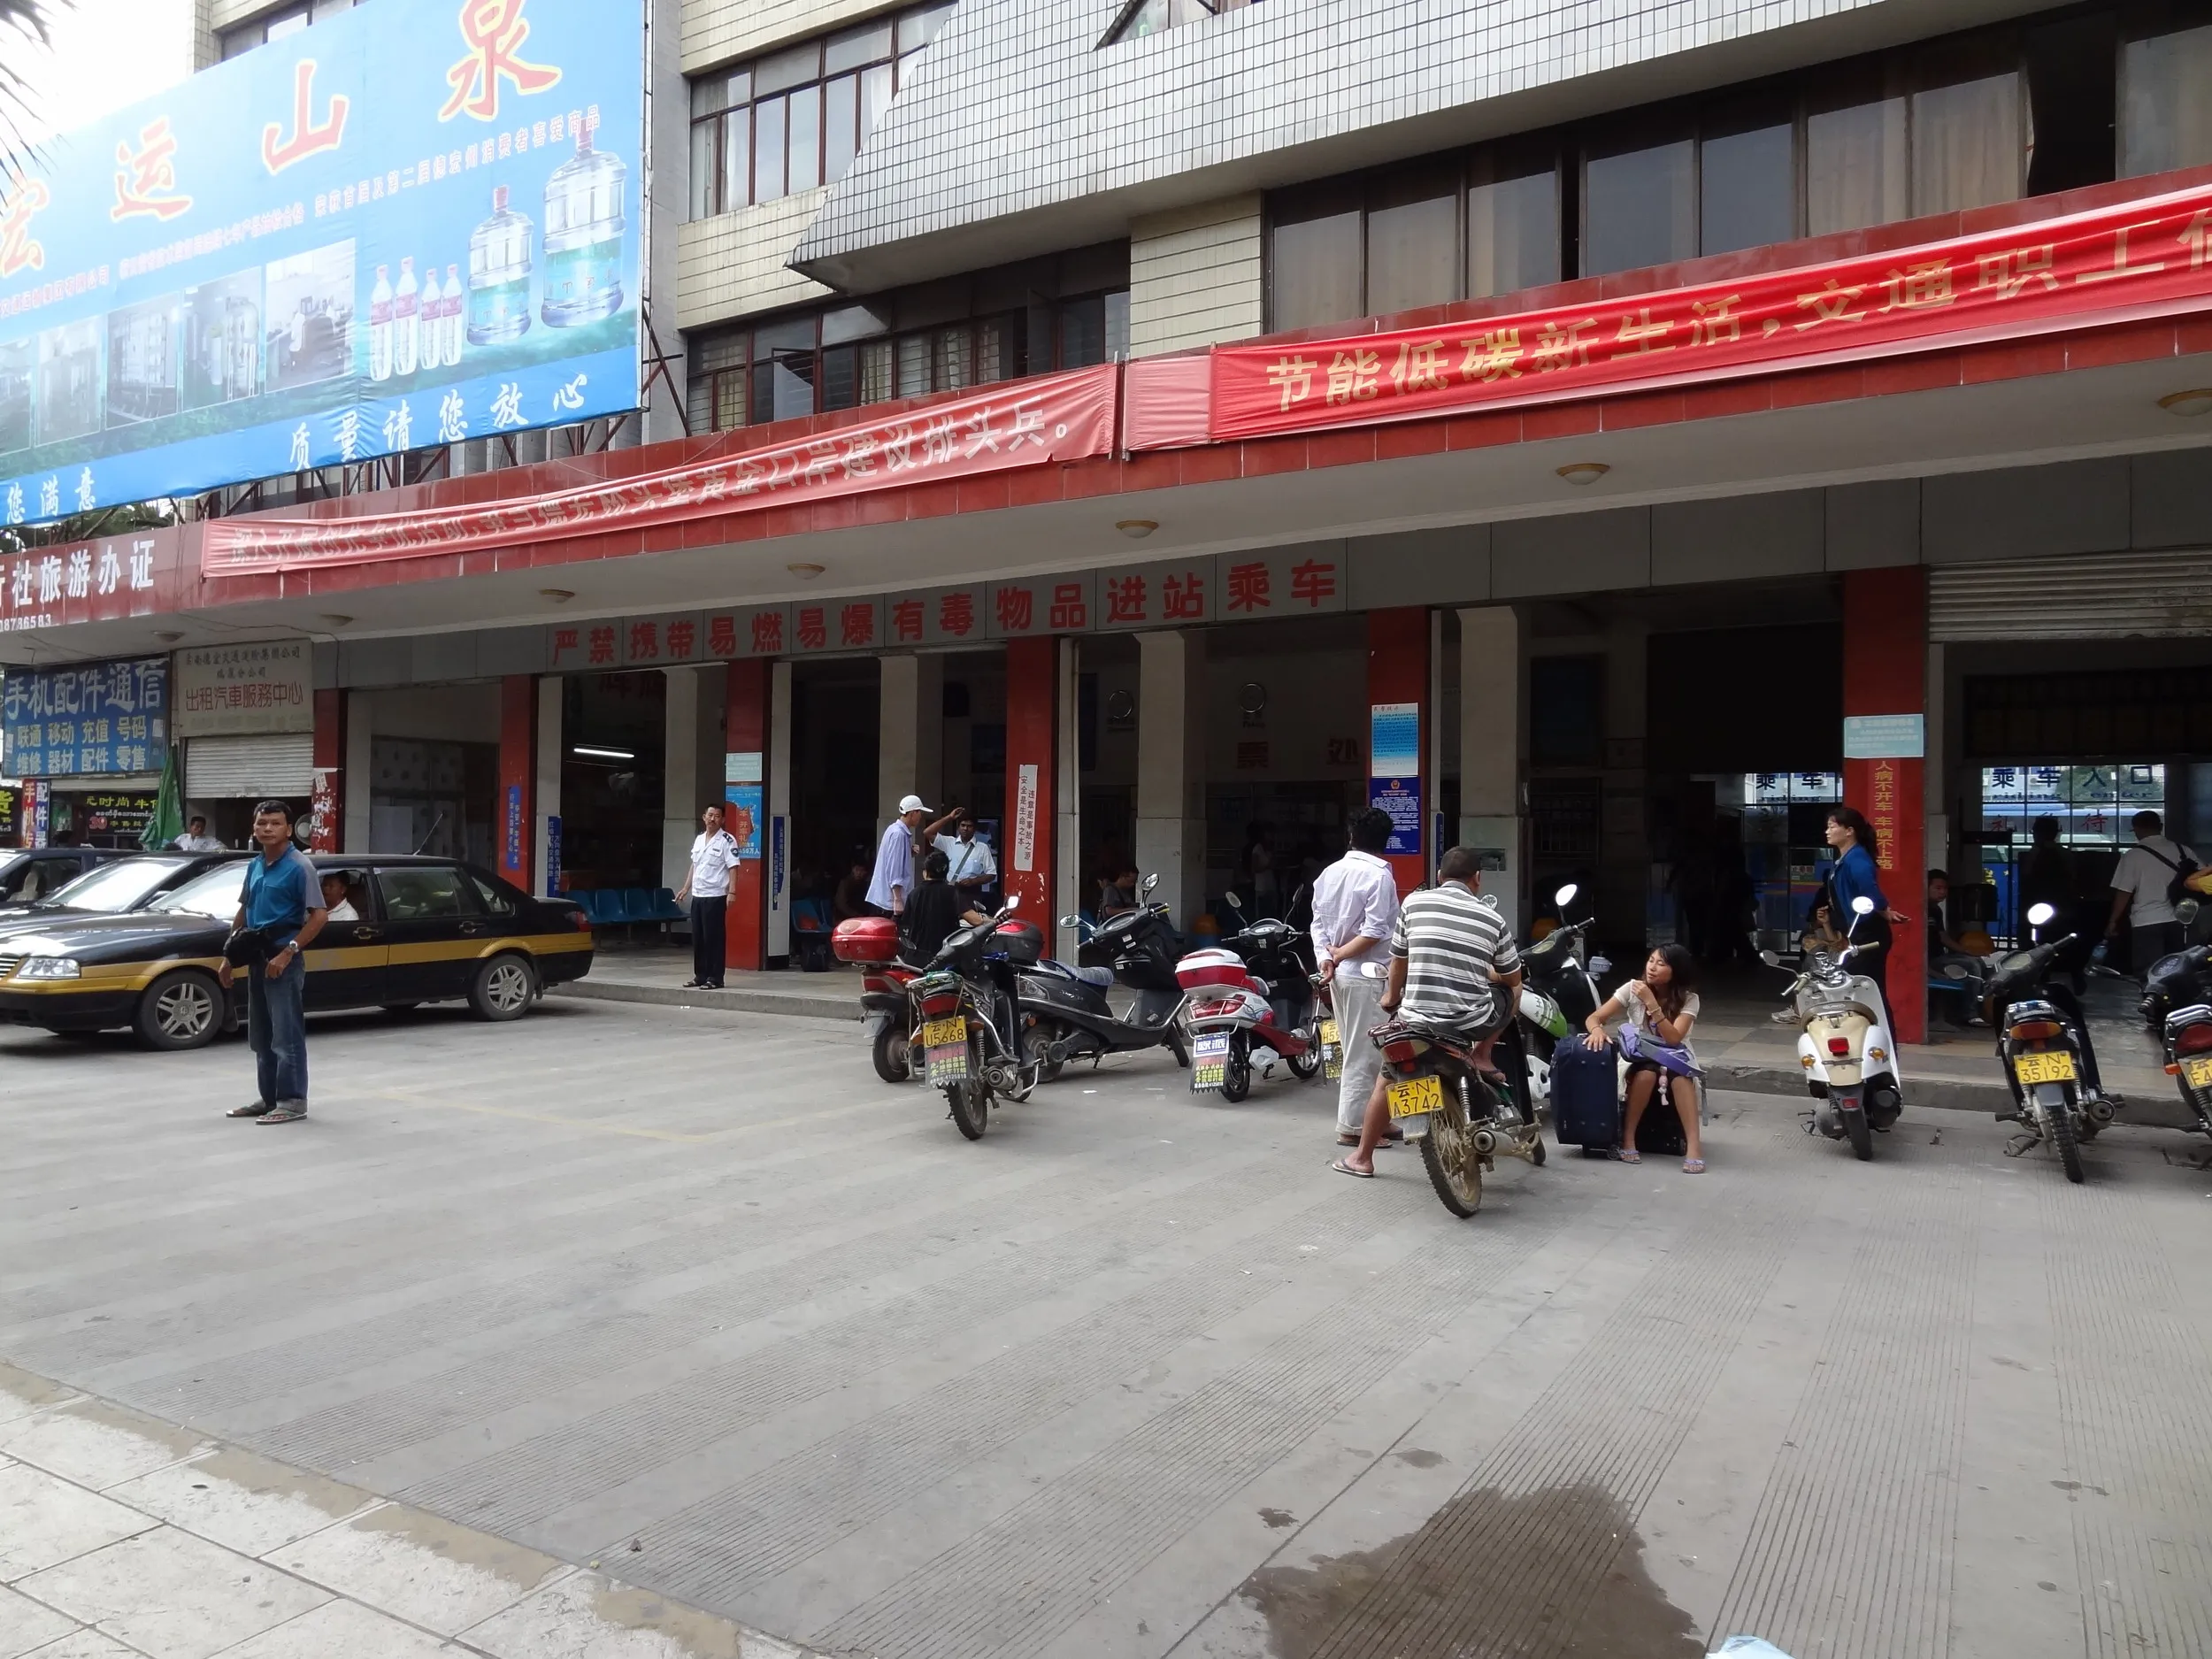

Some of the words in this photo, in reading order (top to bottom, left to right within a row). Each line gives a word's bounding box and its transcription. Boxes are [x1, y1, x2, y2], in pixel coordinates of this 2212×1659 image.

[552, 559, 1335, 666] 严禁携带易燃易爆有毒物品进站乘车
[4, 658, 166, 721] 手机配件通信
[18, 724, 42, 749] 联通
[48, 720, 74, 747] 移动
[81, 718, 110, 745] 充值
[117, 714, 147, 741] 号码
[81, 747, 109, 772] 配件
[116, 744, 146, 772] 零售
[1874, 760, 1893, 811] 人病不开车
[1024, 789, 1035, 860] 违章是事故之源
[1874, 816, 1893, 871] 车病不上路
[926, 1028, 964, 1046] U5668
[2021, 1064, 2071, 1082] 35192
[1392, 1093, 1441, 1118] A3742
